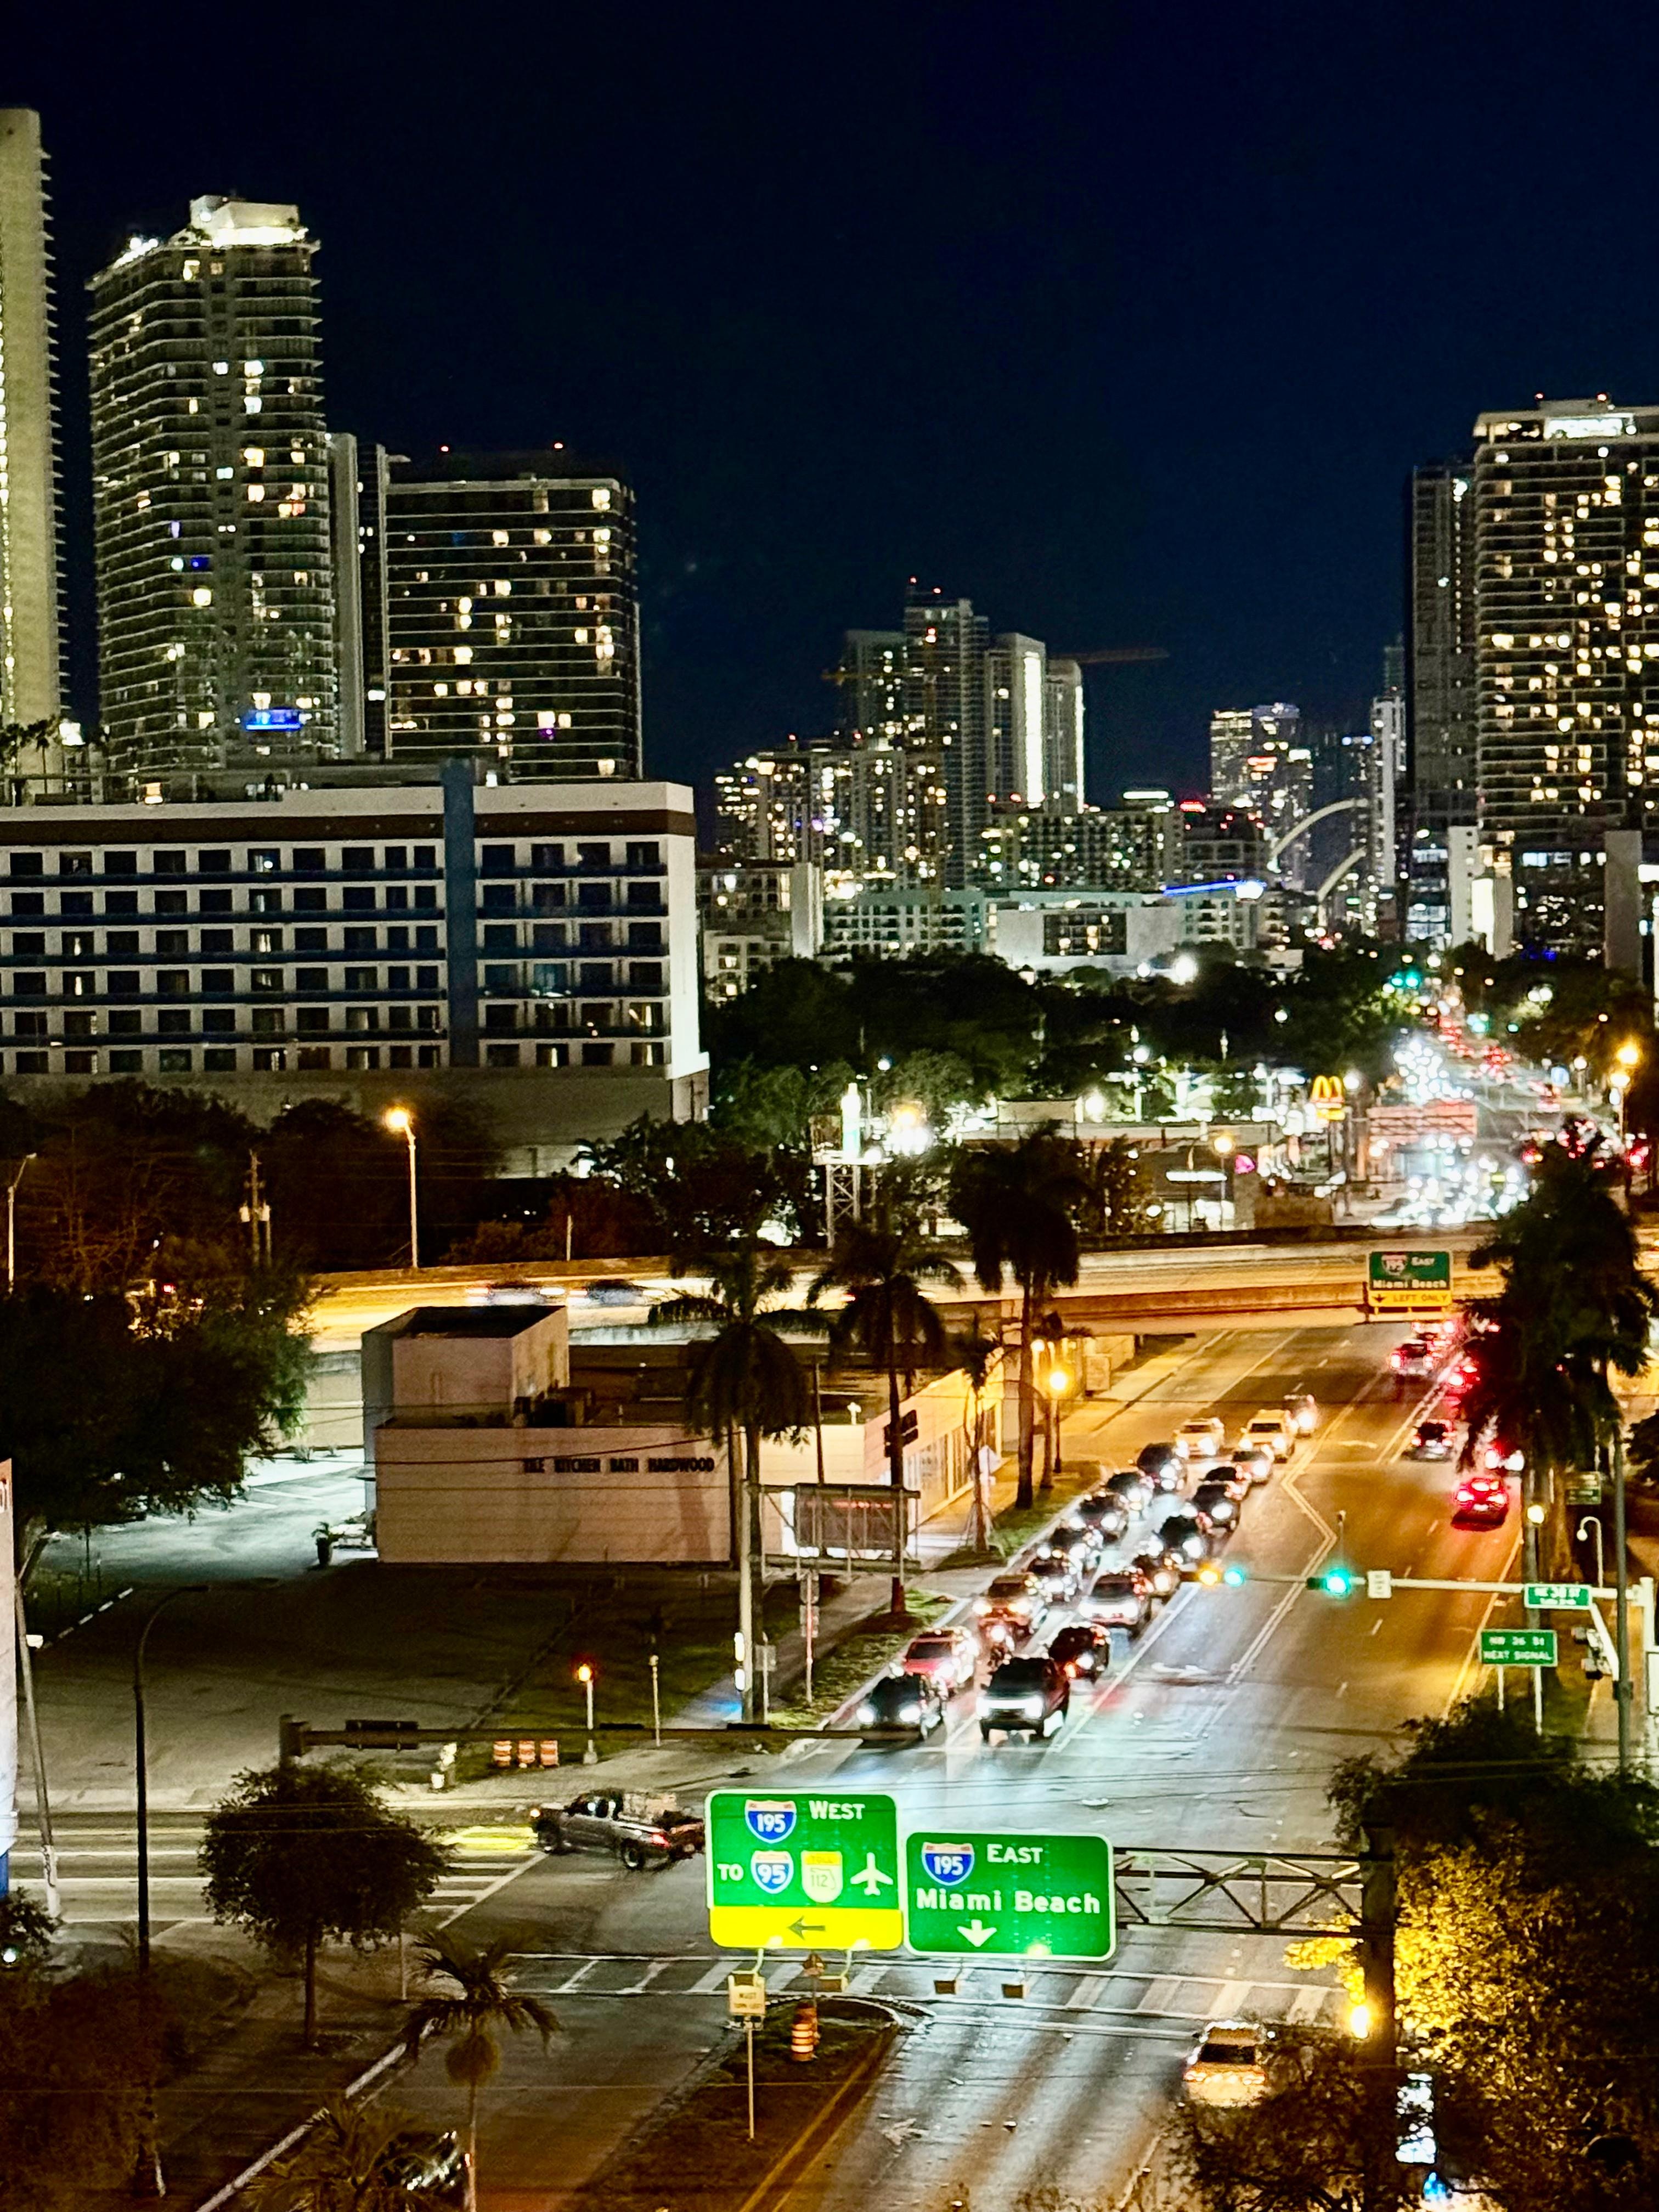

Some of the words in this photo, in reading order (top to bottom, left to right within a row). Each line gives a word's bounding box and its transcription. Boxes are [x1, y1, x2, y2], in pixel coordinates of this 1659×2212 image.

[1373, 1279, 1408, 1289] Miami
[1412, 1279, 1447, 1288] Beach
[1393, 1294, 1417, 1302] LEFT
[1421, 1294, 1448, 1302] ONLY
[554, 1458, 601, 1473] KITCHEN
[610, 1458, 639, 1472] BATH
[648, 1457, 714, 1472] HARDWOOD
[1483, 1650, 1510, 1660] NEXT
[1514, 1650, 1552, 1660] SIGNAL
[757, 1814, 786, 1833] 195
[809, 1800, 865, 1820] WEST
[987, 1843, 1043, 1864] EAST
[717, 1863, 743, 1881] TO
[757, 1864, 787, 1884] 95
[934, 1855, 963, 1876] 195
[811, 1874, 828, 1887] 112
[917, 1888, 1002, 1911] Miami
[1014, 1891, 1100, 1914] Beach
